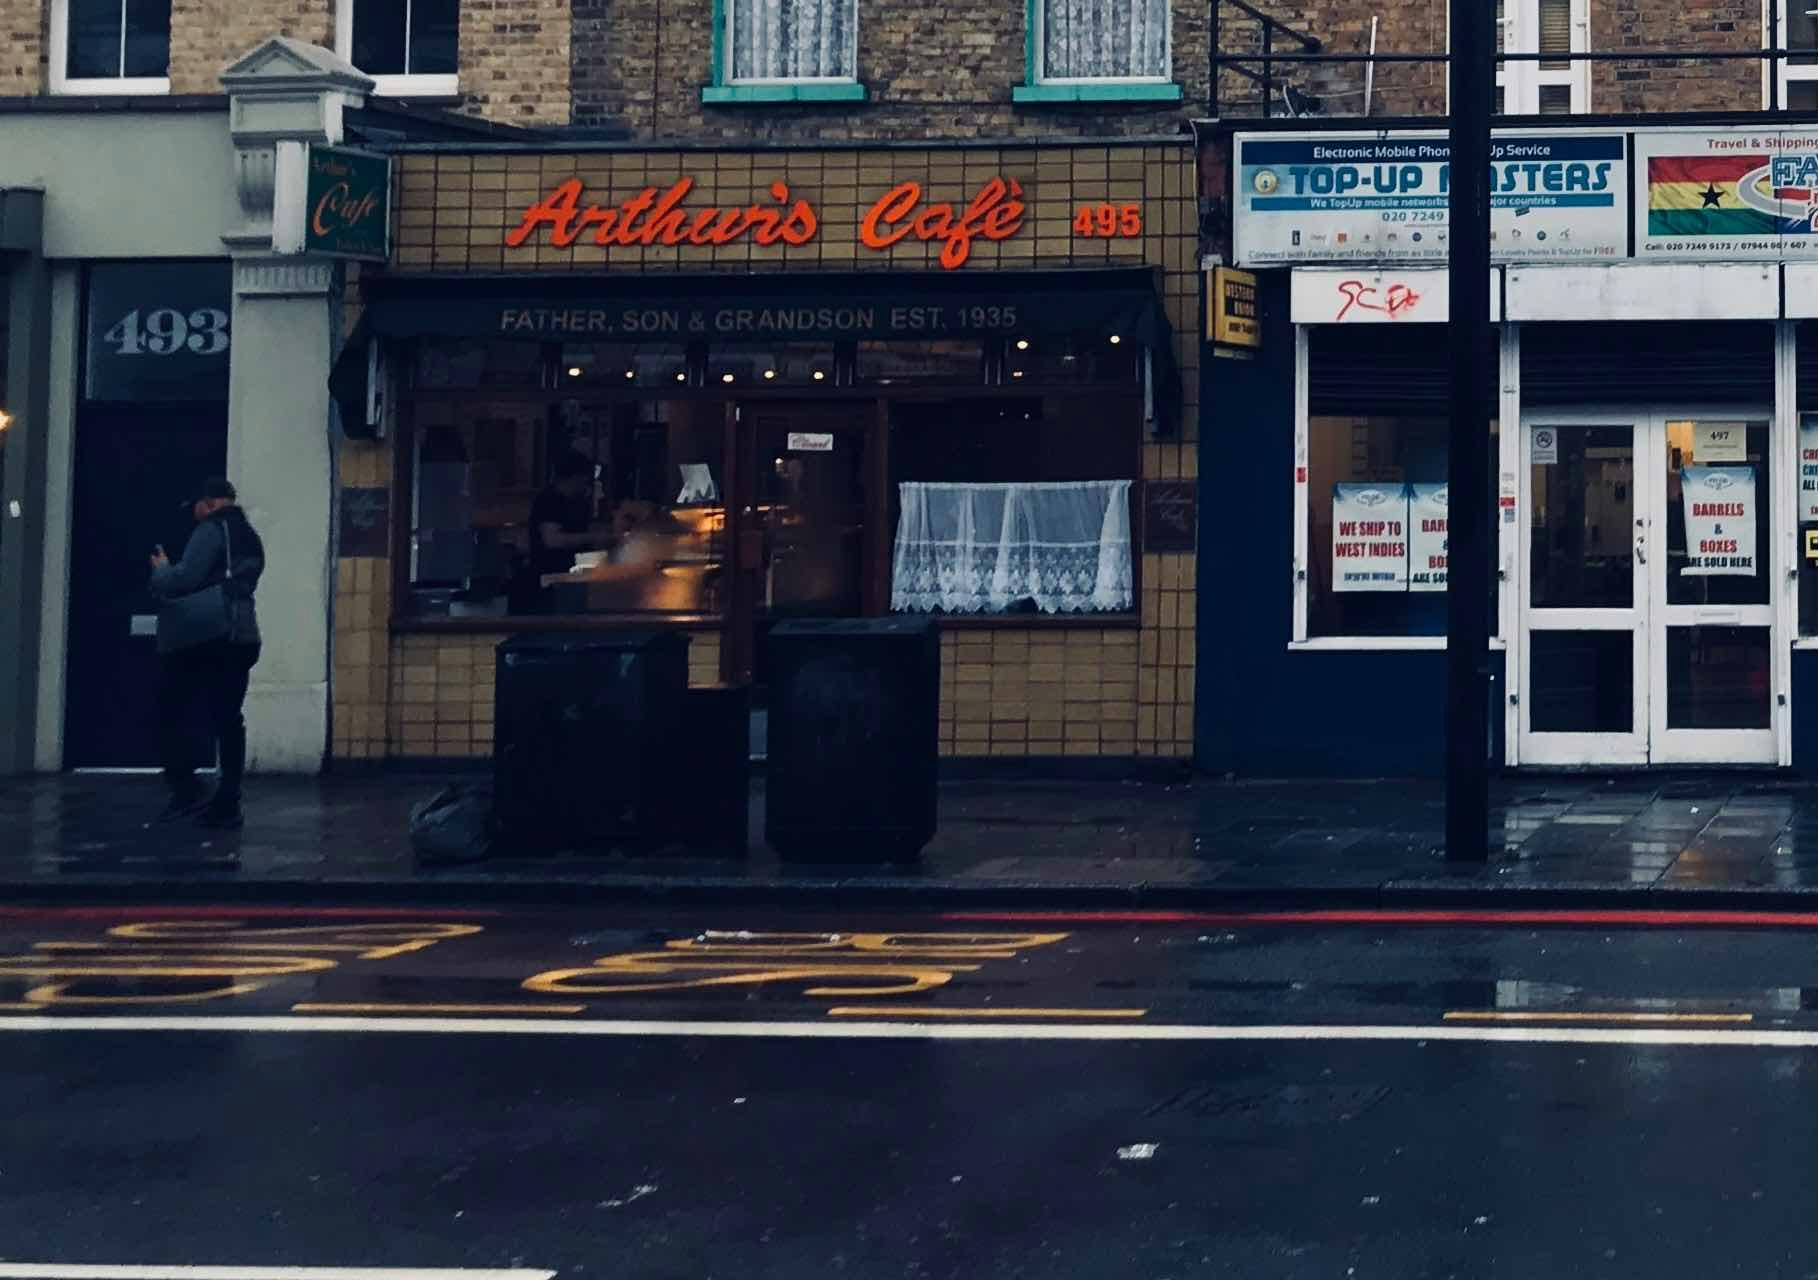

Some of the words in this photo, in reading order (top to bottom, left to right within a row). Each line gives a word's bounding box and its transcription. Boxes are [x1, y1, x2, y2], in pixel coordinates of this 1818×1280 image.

[1706, 138, 1747, 149] Travel
[1751, 138, 1761, 148] &
[1313, 146, 1372, 159] Electronic
[1375, 145, 1416, 158] Mobile
[1419, 145, 1449, 158] Phon
[1507, 144, 1551, 156] Service
[1288, 165, 1423, 194] TOP-UP
[1310, 198, 1327, 208] We
[1364, 197, 1399, 207] mobile
[1509, 196, 1557, 207] countries
[505, 176, 818, 247] Arthur's
[1382, 211, 1407, 221] 020
[1411, 210, 1444, 221] 7249
[1073, 202, 1143, 237] 495
[1666, 242, 1683, 251] 020
[501, 310, 613, 333] FATHER,
[622, 310, 679, 331] SON
[688, 312, 705, 331] &
[714, 308, 874, 331] GRANDSON
[891, 308, 946, 330] EST.
[957, 307, 1017, 329] 1935
[103, 308, 230, 355] 493
[1710, 431, 1729, 441] 497
[1802, 479, 1815, 491] ALL
[1692, 503, 1745, 517] BARRELS
[1339, 521, 1357, 536] WE
[1359, 521, 1385, 536] SHIP
[1387, 521, 1402, 536] TO
[1714, 523, 1723, 535] &
[1335, 542, 1366, 557] WEST
[1369, 542, 1405, 557] INDIES
[1699, 539, 1738, 553] BOXES
[1703, 556, 1728, 568] SOLD
